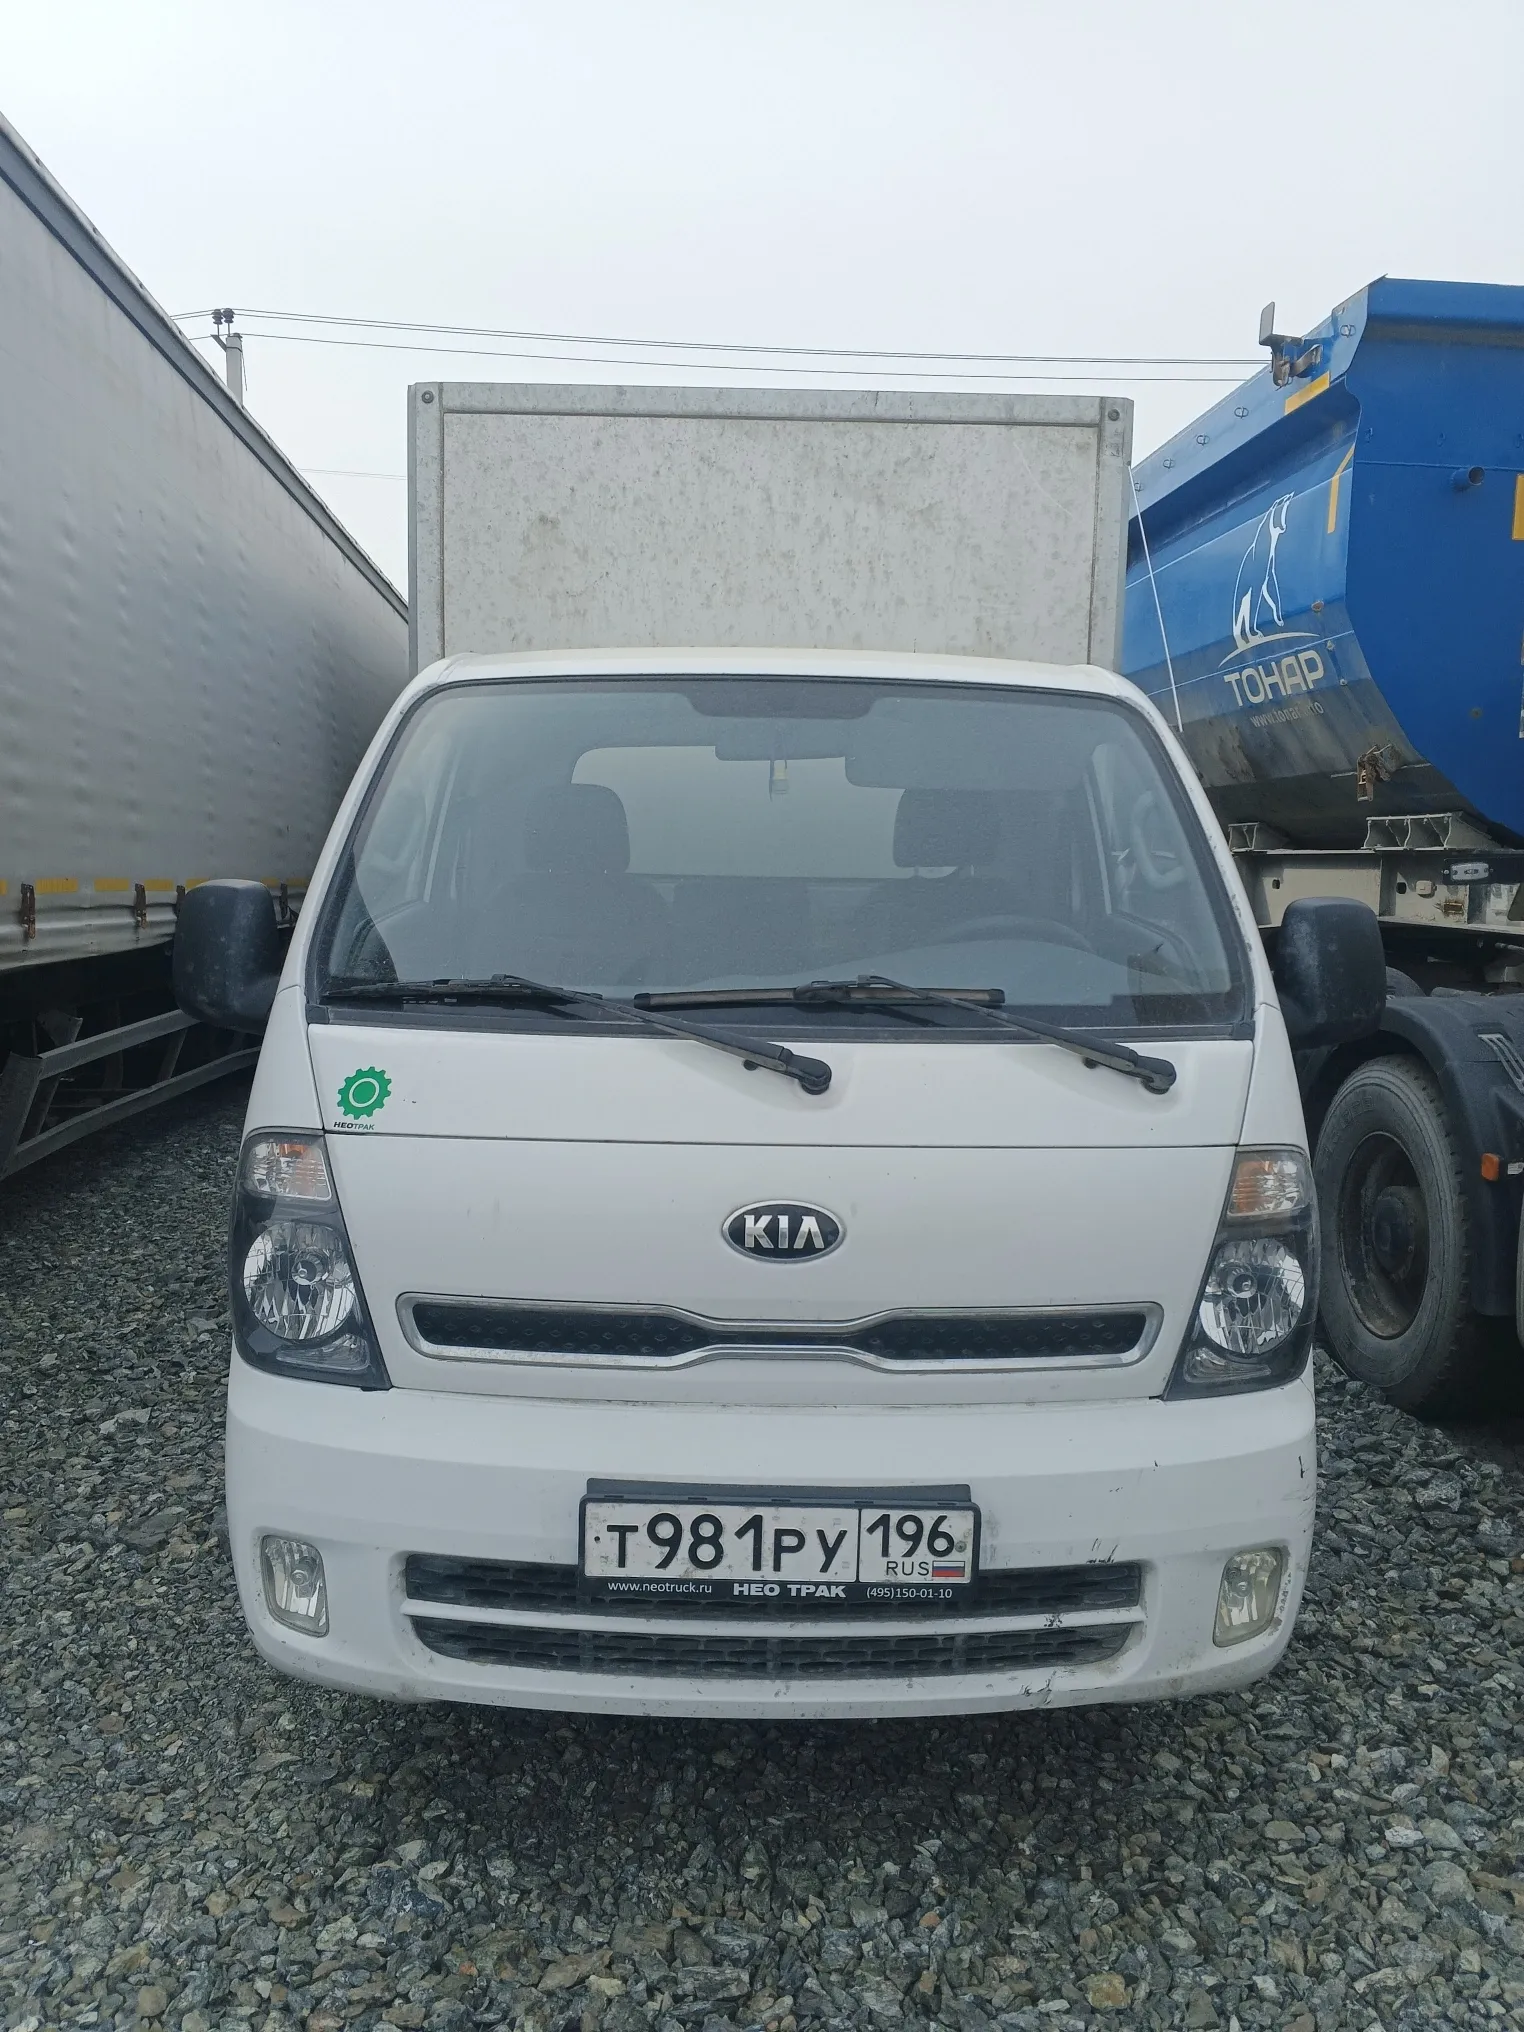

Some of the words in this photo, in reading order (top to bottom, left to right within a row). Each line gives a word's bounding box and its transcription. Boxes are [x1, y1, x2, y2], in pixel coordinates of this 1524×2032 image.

[1223, 650, 1324, 706] ТОНАР
[333, 1121, 375, 1130] НЕОТРАК
[744, 1215, 825, 1249] KIA
[865, 1514, 955, 1558] 196
[885, 1560, 930, 1577] RUS
[607, 1581, 712, 1595] www.neotruck.ru
[733, 1583, 780, 1597] НЕО
[787, 1585, 846, 1599] ТРАК
[866, 1586, 953, 1600] (495)150-01-10
